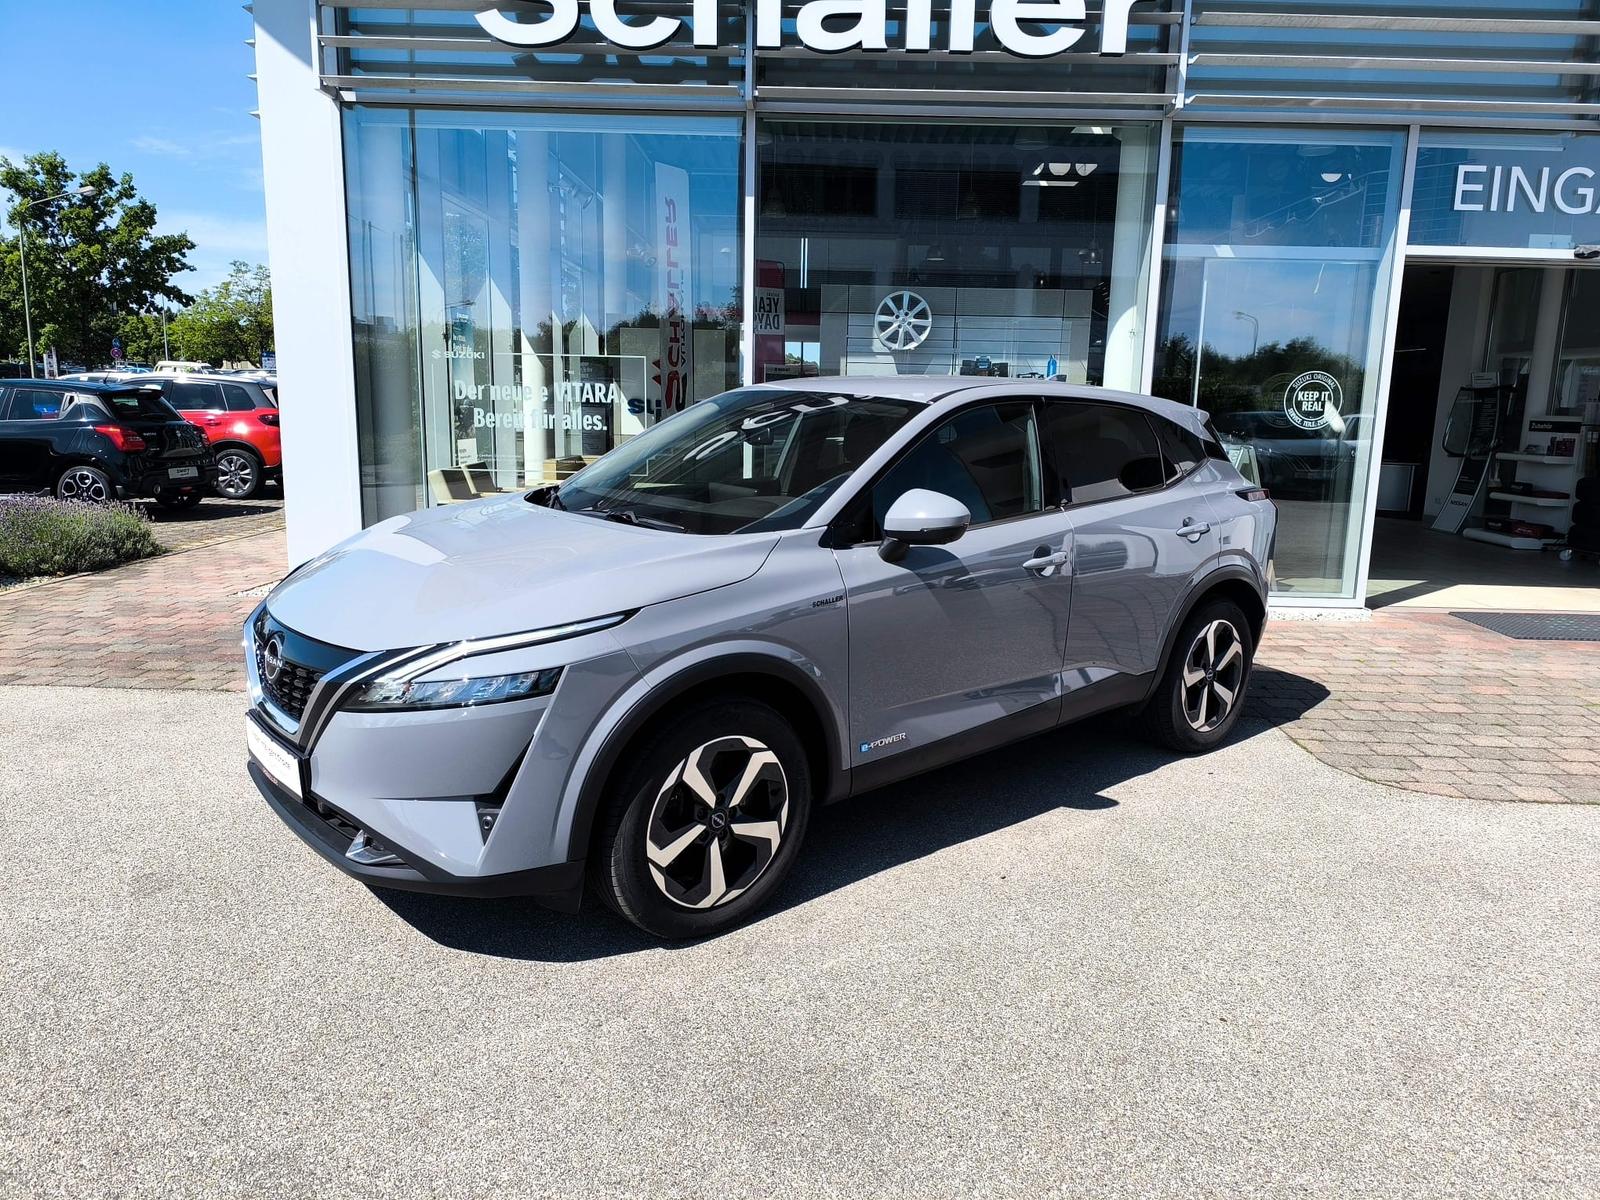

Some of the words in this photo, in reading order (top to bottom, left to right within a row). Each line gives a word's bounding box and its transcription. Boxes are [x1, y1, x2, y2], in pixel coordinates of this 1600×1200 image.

[1453, 165, 1600, 215] EING
[1293, 374, 1312, 389] SUZUKI
[1314, 374, 1336, 389] ORIGINAL
[454, 380, 487, 400] Der
[554, 382, 620, 404] VITARA
[1298, 392, 1319, 401] KEEP
[1321, 391, 1330, 401] IT
[1302, 402, 1323, 411] REAL
[562, 410, 608, 431] alles.
[812, 595, 844, 608] SCHALLER
[264, 652, 283, 667] SSAN
[860, 732, 906, 752] e-POWER
